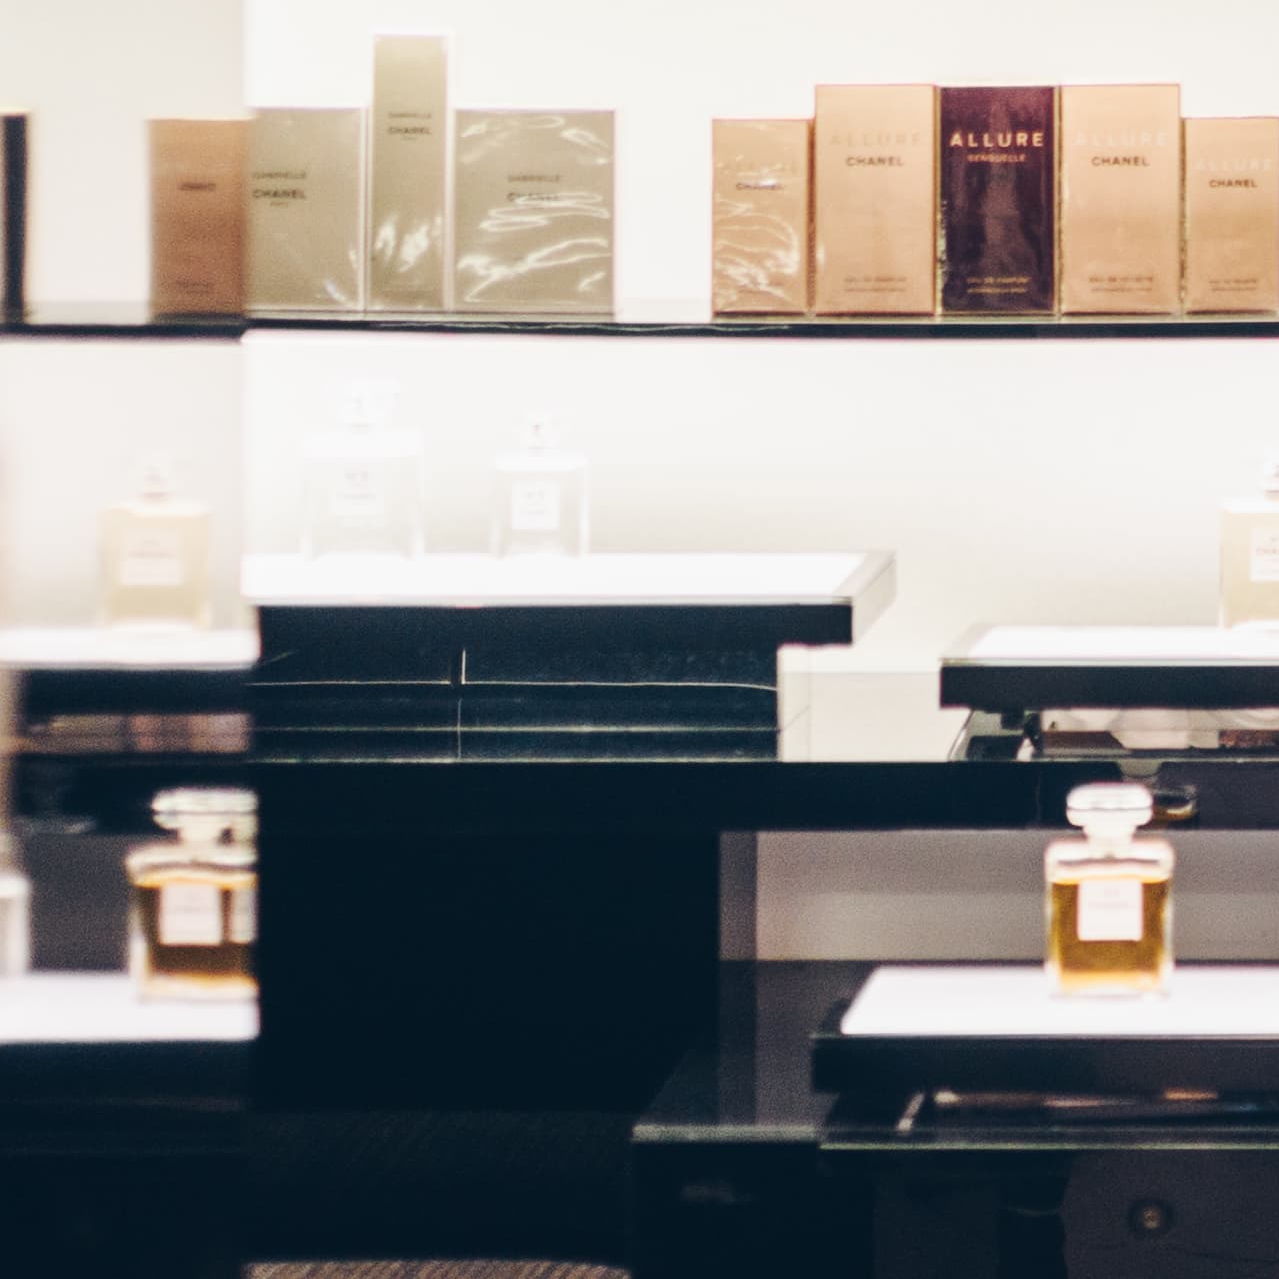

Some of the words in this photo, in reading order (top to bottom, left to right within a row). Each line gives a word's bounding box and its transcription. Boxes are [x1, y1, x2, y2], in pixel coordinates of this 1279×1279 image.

[949, 132, 1045, 148] ALLURE
[1073, 131, 1168, 146] ALLURE
[846, 156, 904, 167] CHANEL
[1091, 156, 1150, 167] CHANEL
[1208, 179, 1258, 188] CHANEL
[252, 189, 306, 199] CHANEL
